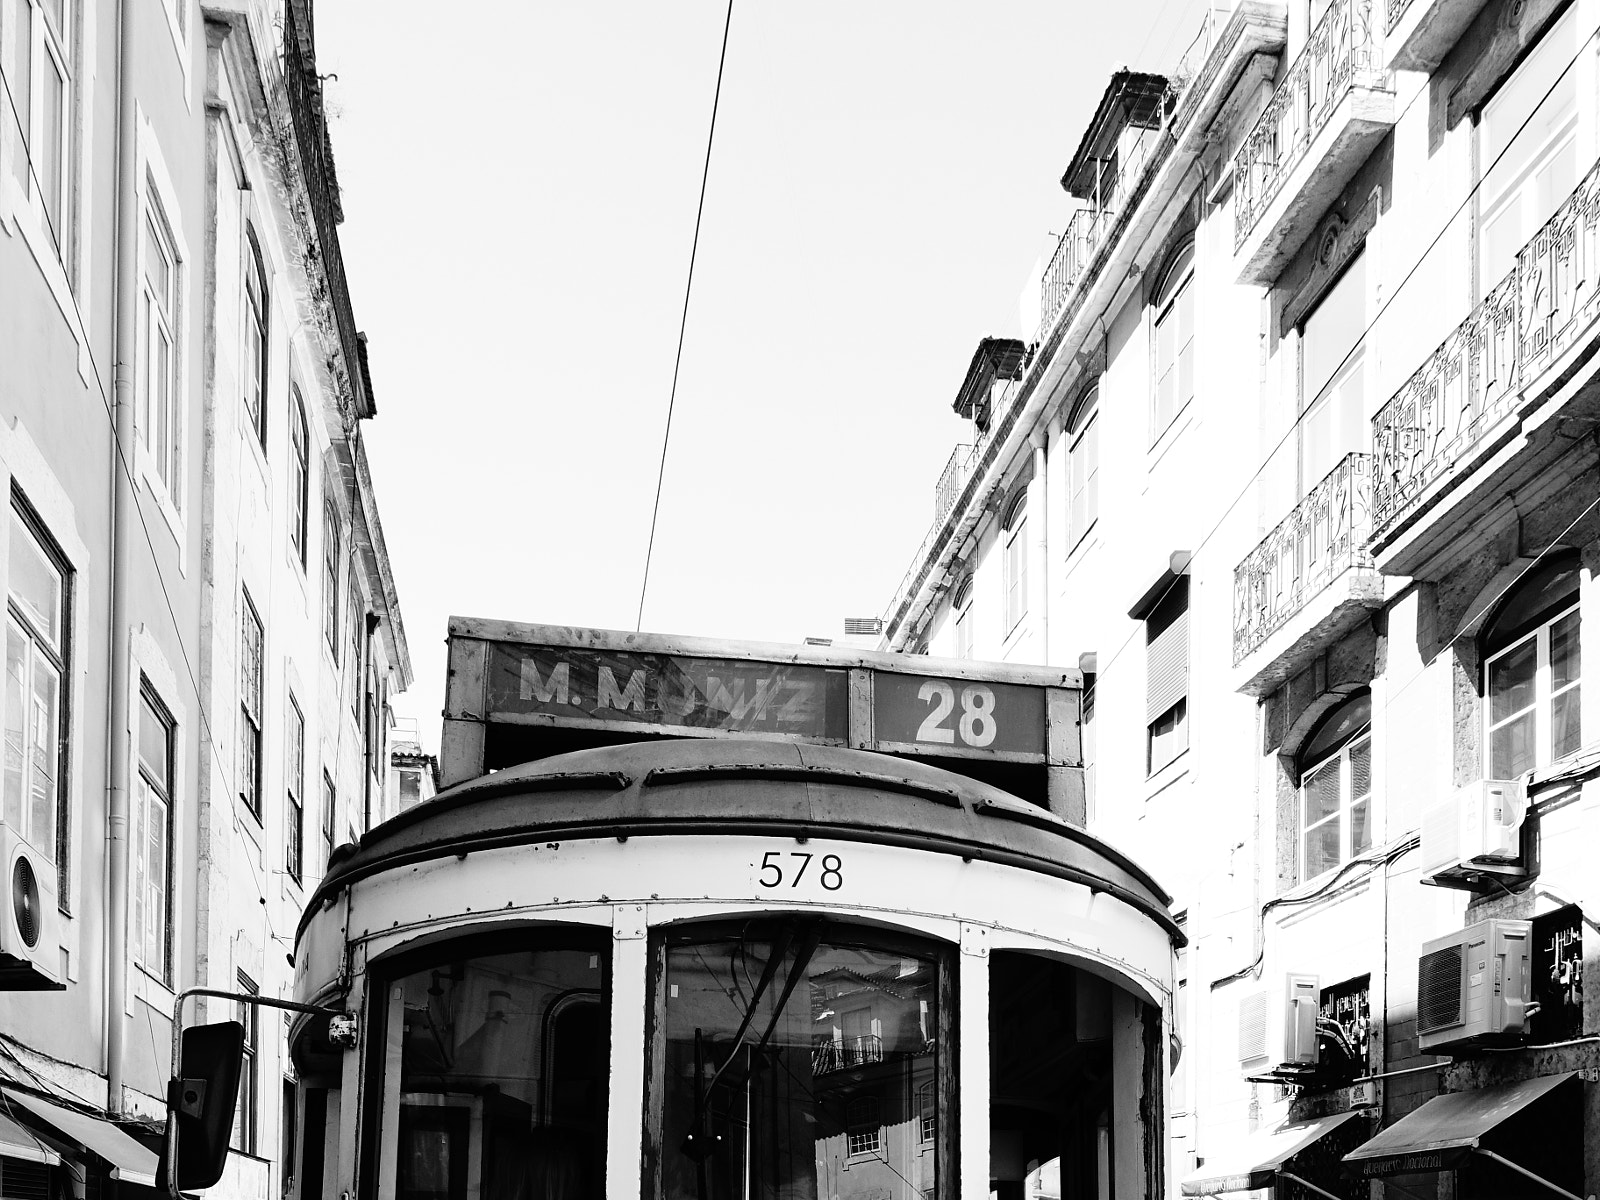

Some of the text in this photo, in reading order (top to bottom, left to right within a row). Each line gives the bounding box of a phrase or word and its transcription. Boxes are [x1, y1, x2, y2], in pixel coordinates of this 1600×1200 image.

[519, 658, 582, 706] M.
[915, 680, 997, 747] 28
[758, 851, 843, 891] 578
